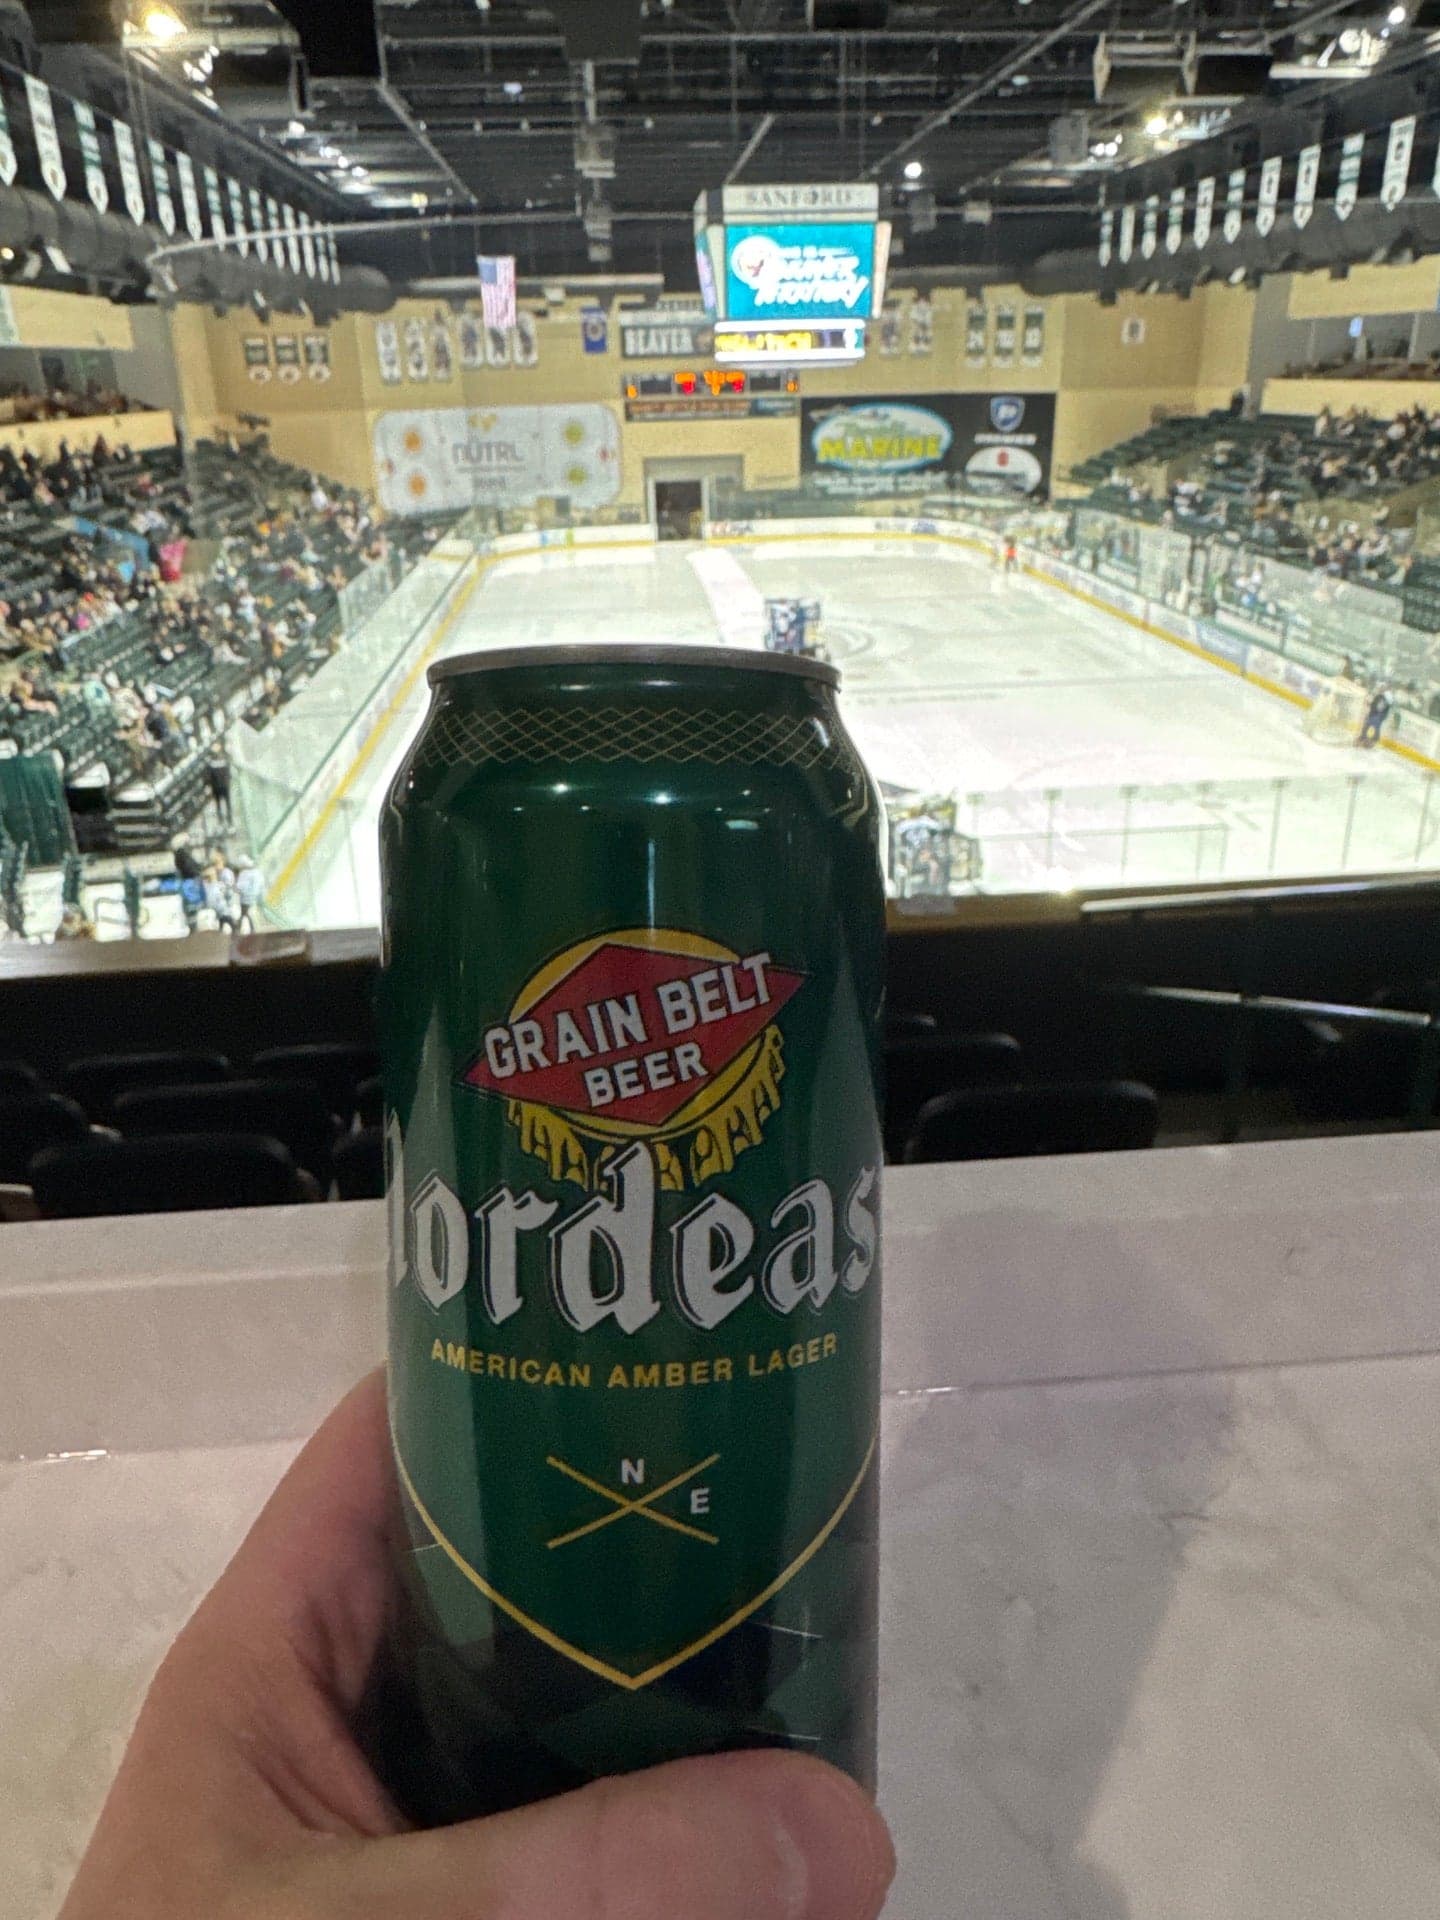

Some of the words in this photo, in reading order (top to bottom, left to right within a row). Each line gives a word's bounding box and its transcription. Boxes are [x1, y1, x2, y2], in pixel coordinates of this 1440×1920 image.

[818, 434, 942, 461] MARINE
[484, 994, 645, 1079] GRAIN
[656, 953, 772, 1033] BELT
[583, 1043, 709, 1108] BEER
[431, 1339, 591, 1387] AMERICAN
[608, 1357, 734, 1388] AMBER
[748, 1334, 838, 1377] LAGER
[621, 1458, 645, 1484] N
[691, 1488, 710, 1514] E
